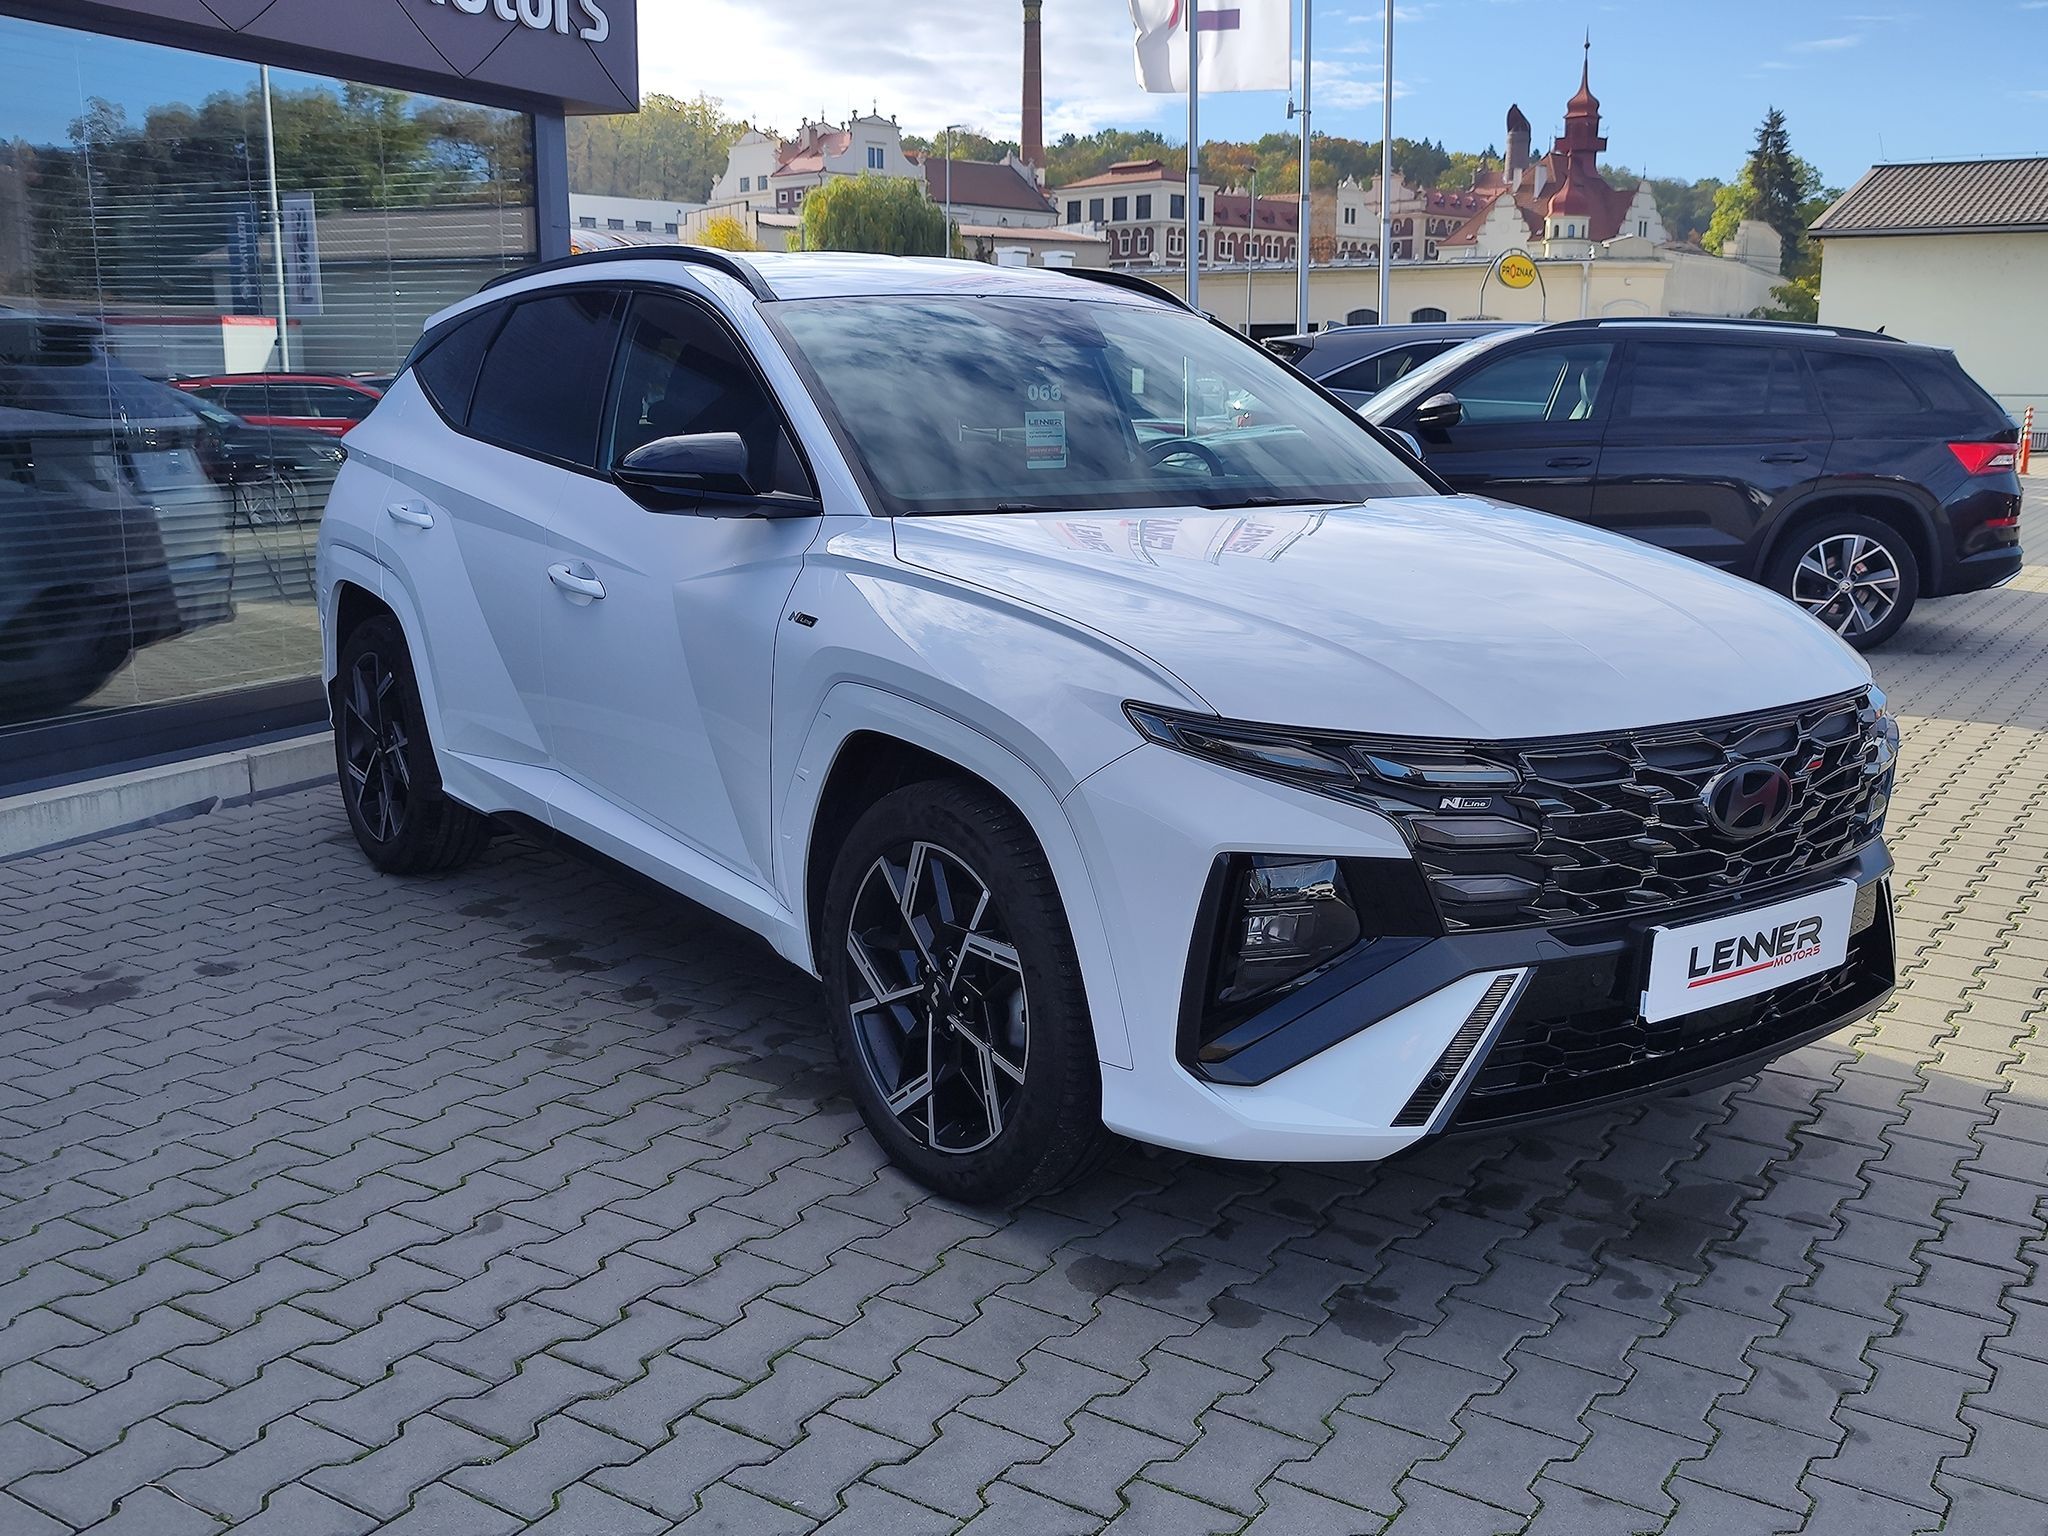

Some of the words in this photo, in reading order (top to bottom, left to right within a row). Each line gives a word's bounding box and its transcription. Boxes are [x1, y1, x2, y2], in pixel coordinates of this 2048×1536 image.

[431, 0, 609, 43] ors
[1440, 797, 1461, 809] N
[1688, 915, 1823, 980] LENNER
[1773, 944, 1821, 968] MOTORS
